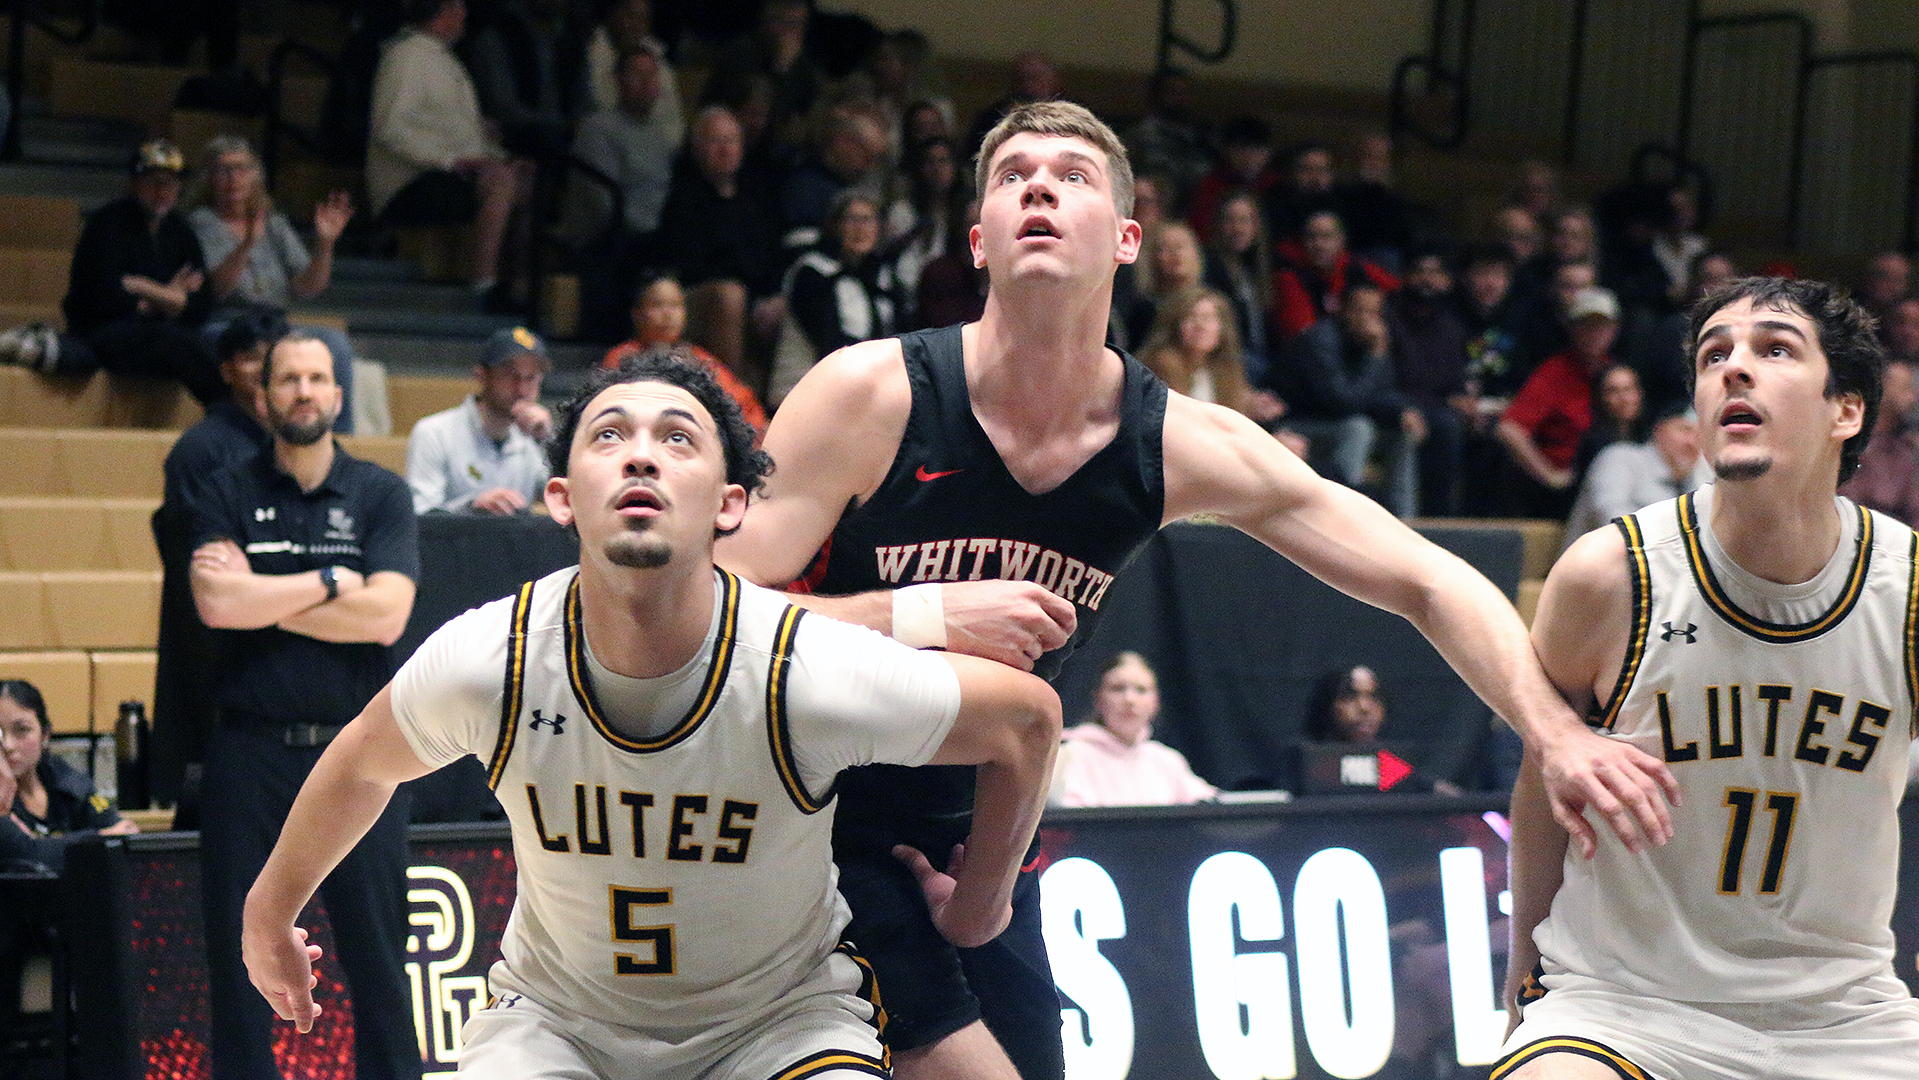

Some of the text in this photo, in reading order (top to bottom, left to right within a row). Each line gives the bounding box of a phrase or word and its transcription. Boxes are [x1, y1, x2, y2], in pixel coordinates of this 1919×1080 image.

[875, 538, 1114, 611] WHITWORTH
[1657, 684, 1893, 773] LUTES
[525, 783, 759, 863] LUTES
[1717, 787, 1799, 896] 11
[608, 884, 677, 976] 5
[1188, 847, 1395, 1080] GO
